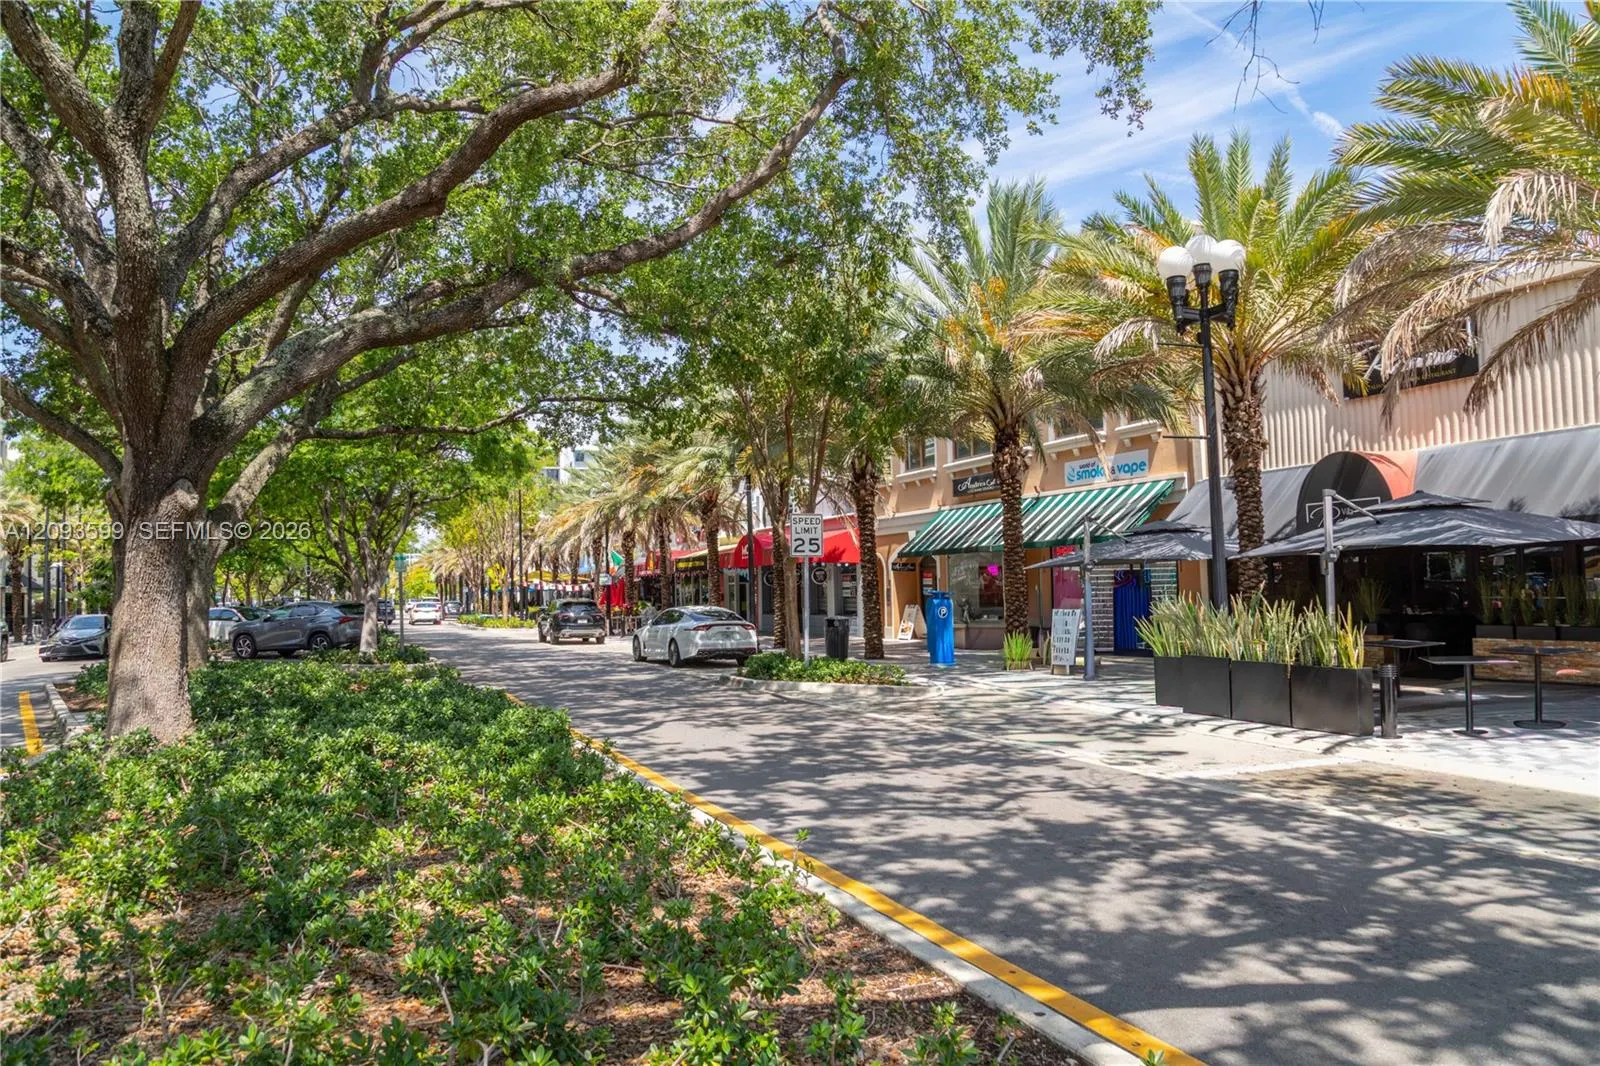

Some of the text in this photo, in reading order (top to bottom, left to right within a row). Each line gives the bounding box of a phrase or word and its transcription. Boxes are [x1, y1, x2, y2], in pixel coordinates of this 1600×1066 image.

[1076, 465, 1104, 480] smok
[1117, 461, 1147, 476] vape
[792, 517, 821, 525] SPEED
[793, 538, 820, 553] 25
